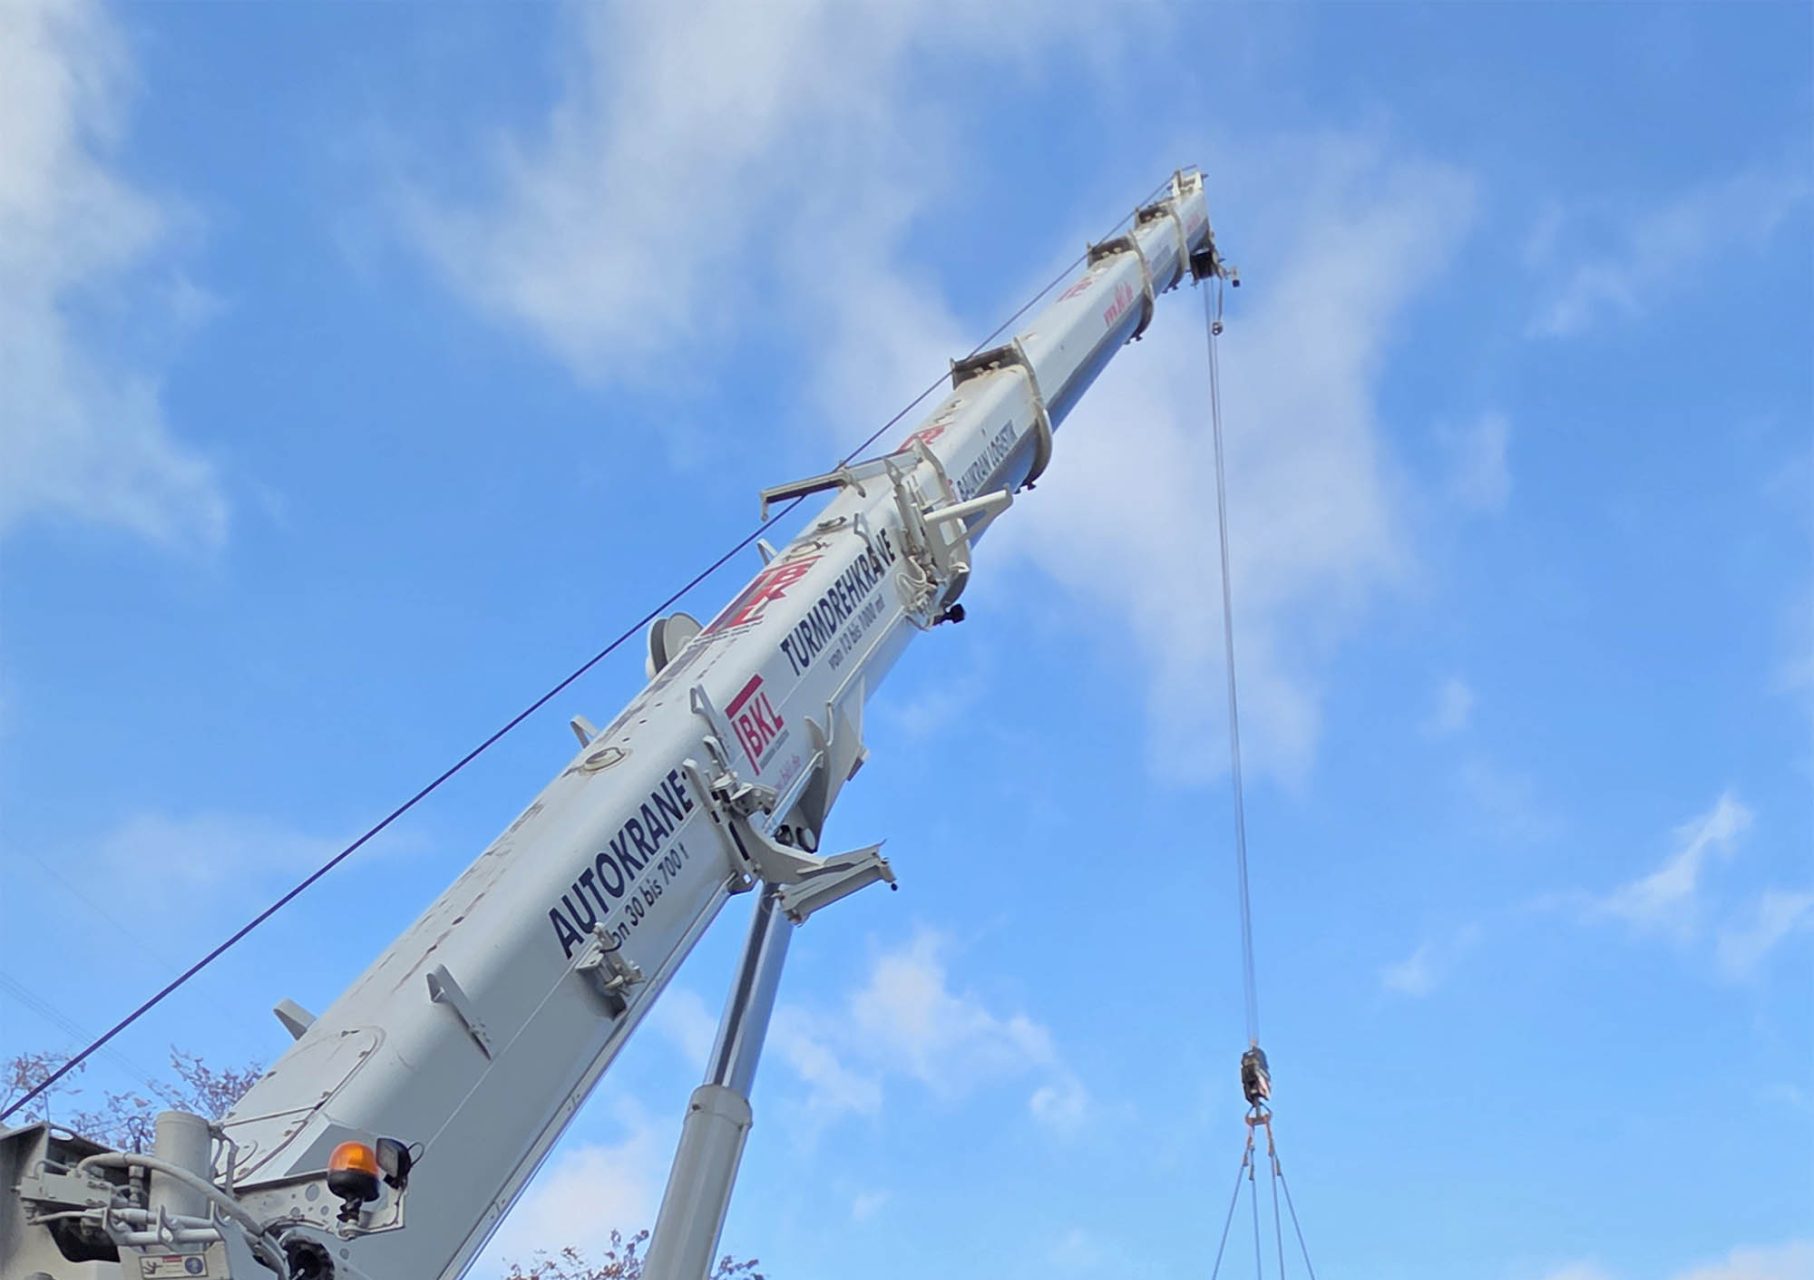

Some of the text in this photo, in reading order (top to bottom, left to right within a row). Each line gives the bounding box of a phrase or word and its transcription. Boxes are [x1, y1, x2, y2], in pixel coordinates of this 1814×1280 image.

[738, 691, 784, 760] BKL
[549, 768, 694, 960] AUTOKRANE
[625, 896, 645, 927] 30
[639, 878, 663, 907] bis
[657, 848, 682, 886] 700
